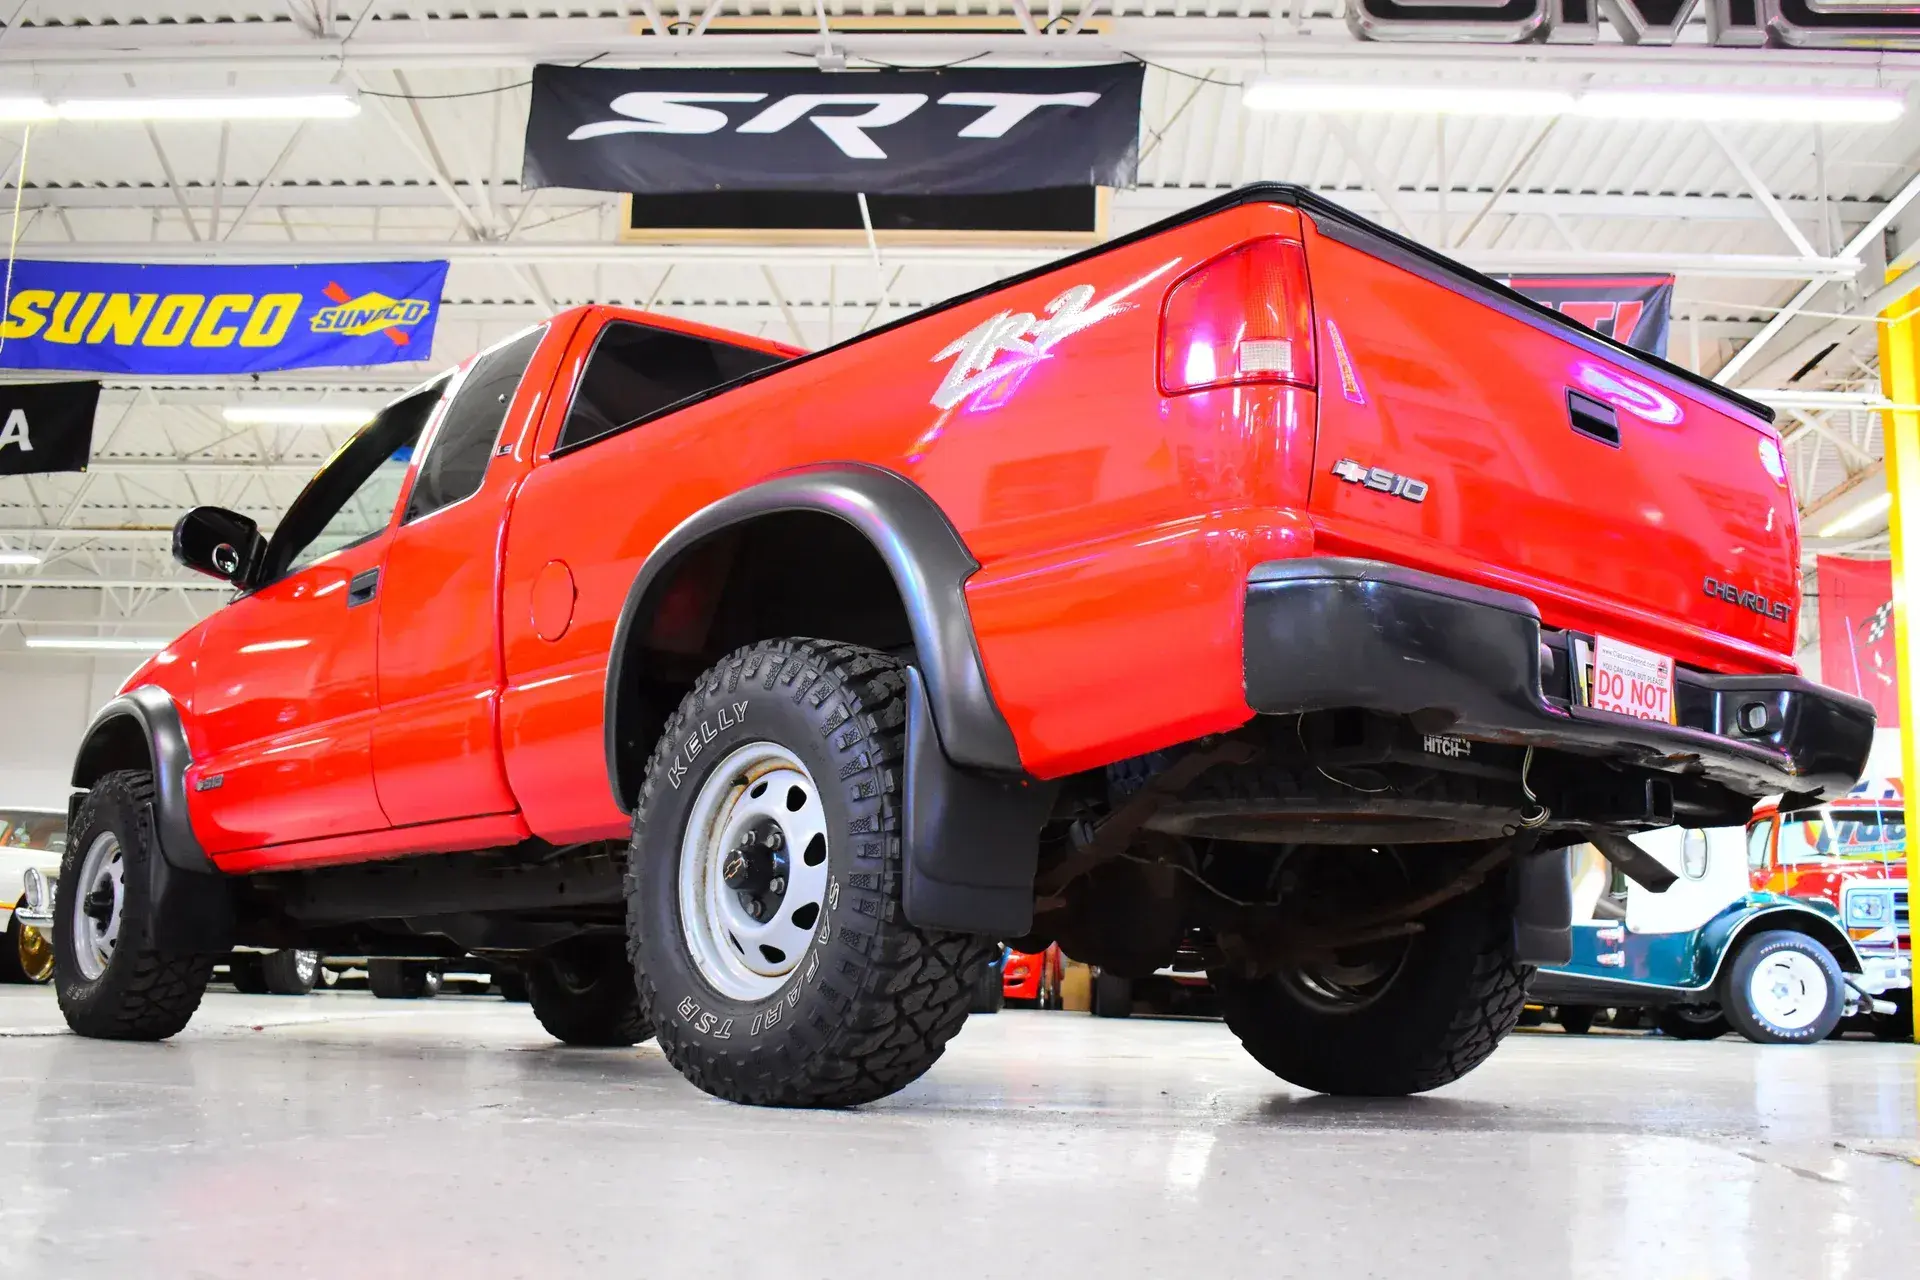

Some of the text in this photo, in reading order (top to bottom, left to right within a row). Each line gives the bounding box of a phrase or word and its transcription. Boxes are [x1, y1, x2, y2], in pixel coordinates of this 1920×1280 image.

[567, 91, 1101, 159] SRT
[0, 290, 303, 348] SUNOCO
[317, 299, 429, 329] SUNOCO
[930, 265, 1165, 410] ZR2
[1364, 466, 1429, 503] S10
[1703, 575, 1791, 623] CHEVROLET
[1598, 669, 1624, 700] DO
[1631, 679, 1668, 712] NOT
[1602, 662, 1664, 687] YOU CAN LOOK BUT PLEASE
[667, 700, 749, 790] KELLY
[1423, 736, 1459, 757] HITCH
[676, 874, 840, 1039] SAFARI TSR
